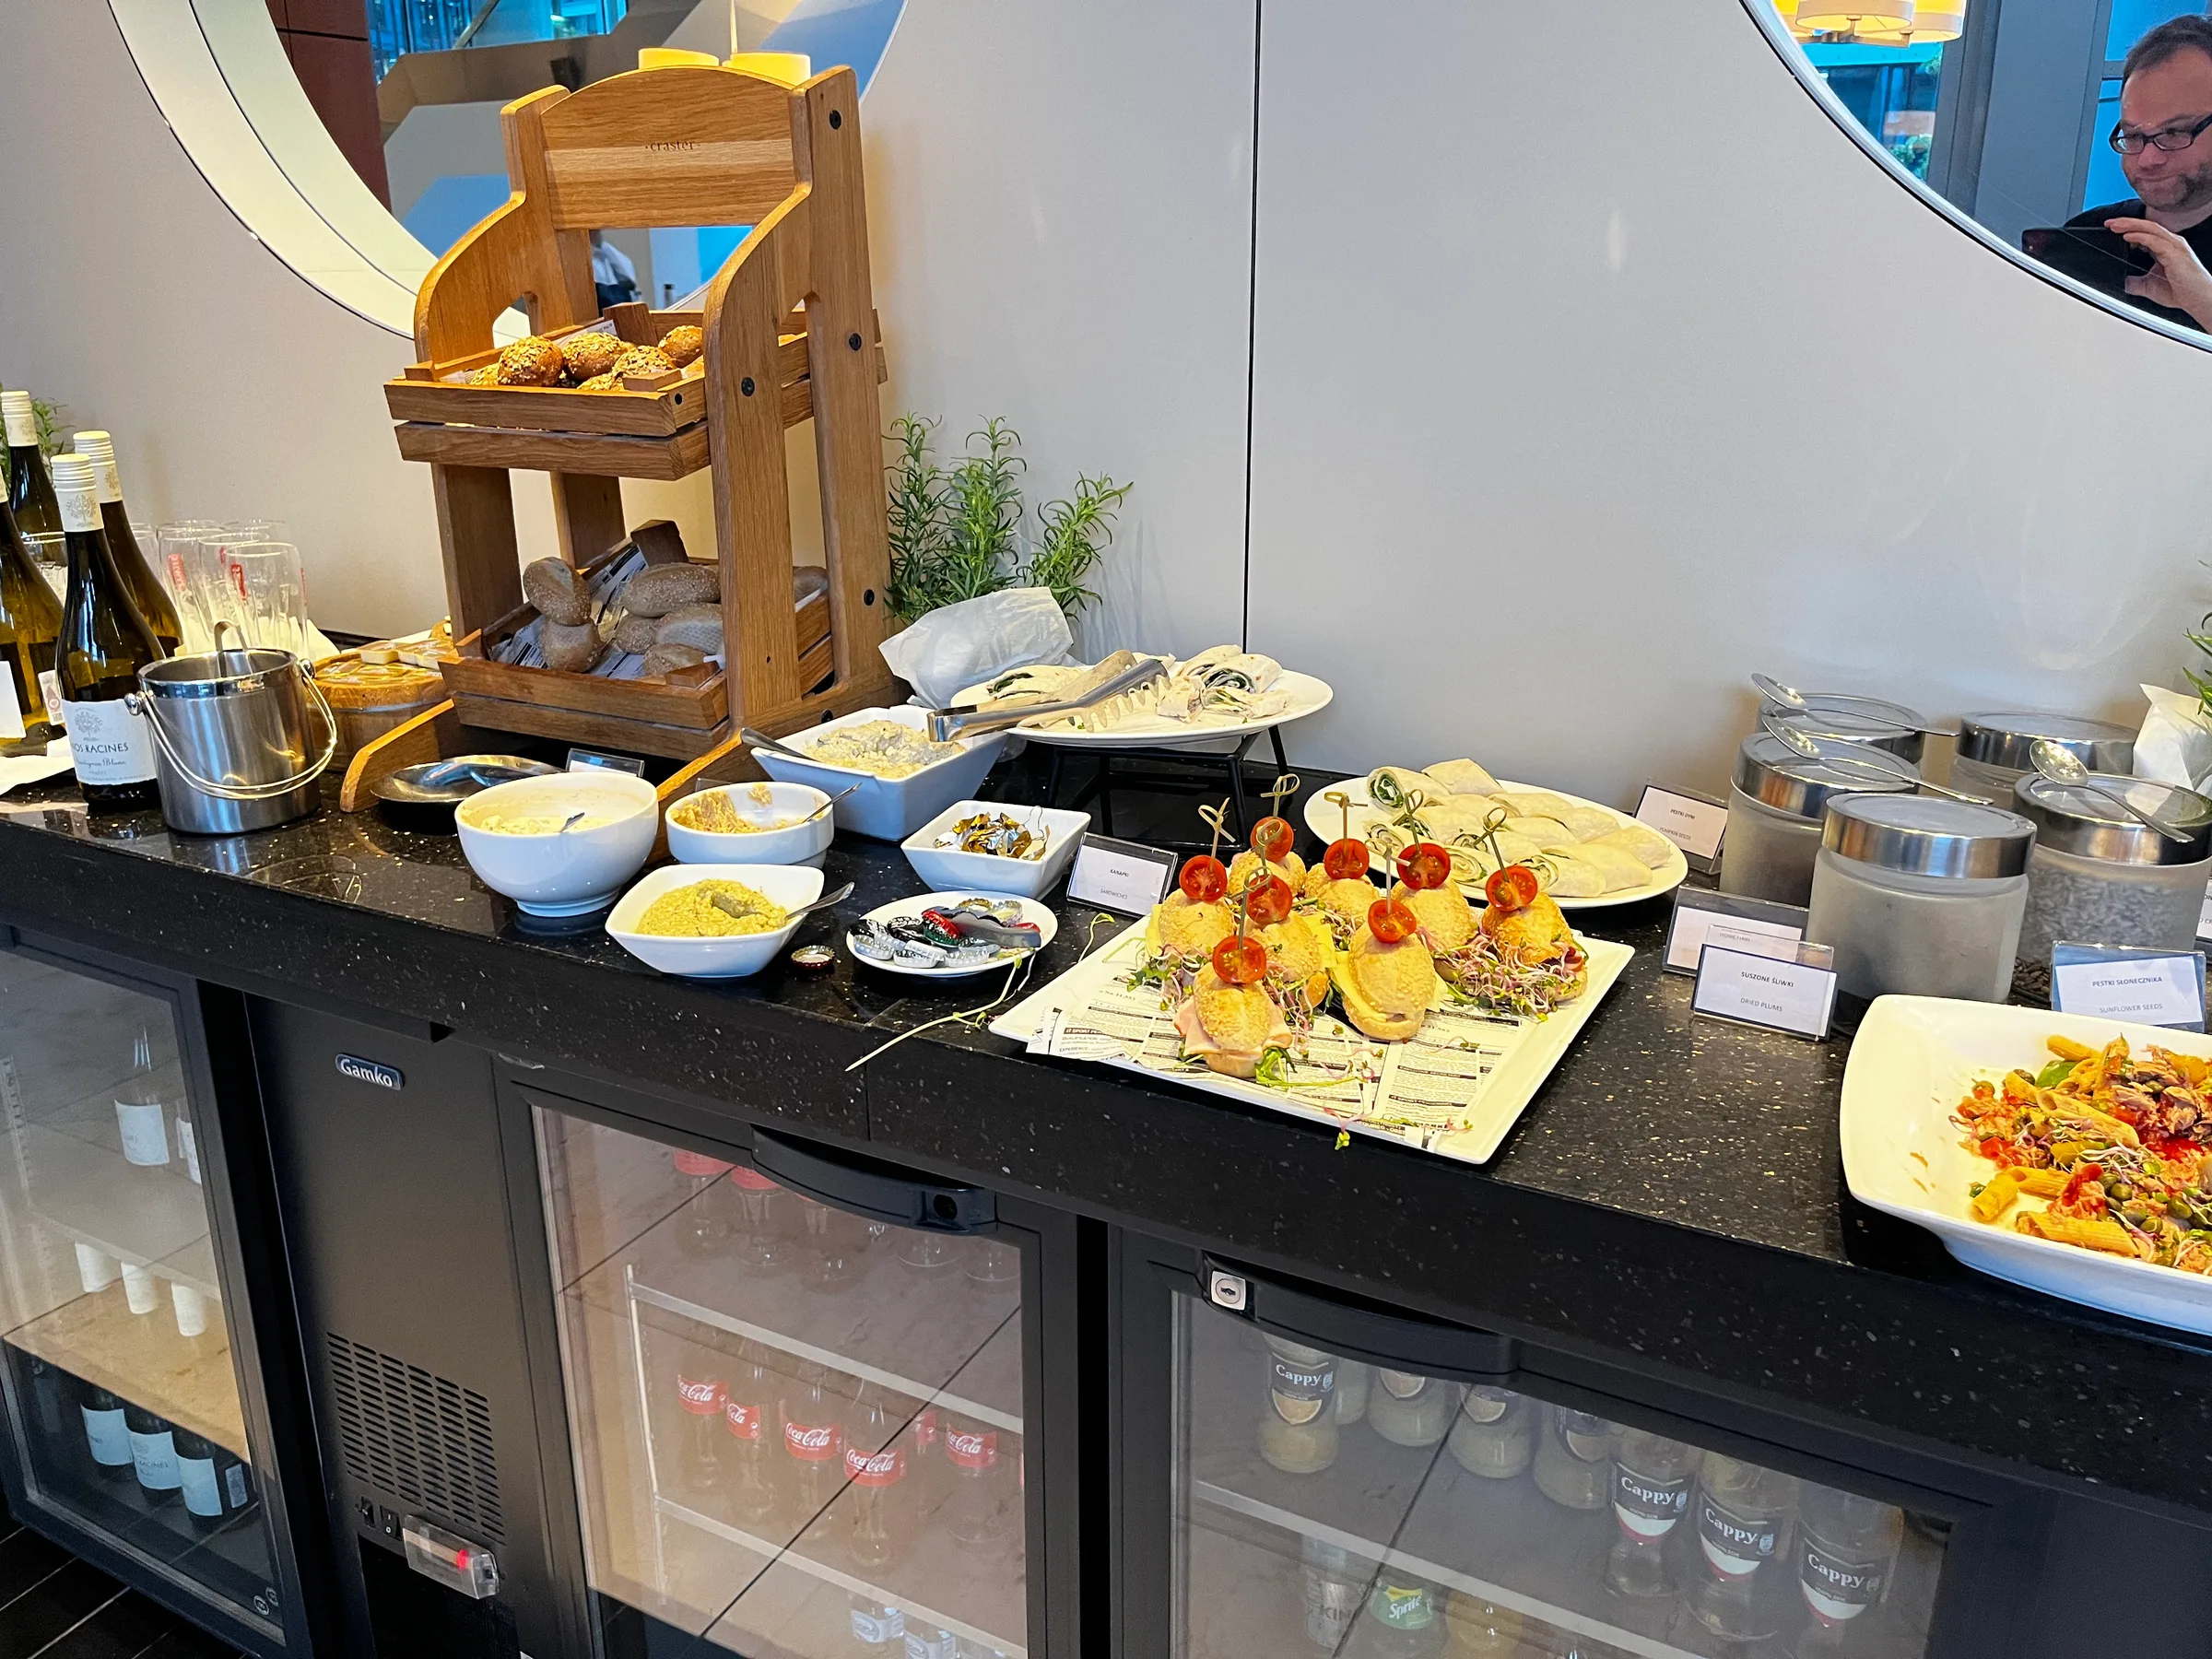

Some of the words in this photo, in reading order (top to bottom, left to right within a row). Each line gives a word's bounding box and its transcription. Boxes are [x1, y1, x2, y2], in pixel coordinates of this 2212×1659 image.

[650, 141, 696, 152] craster
[86, 742, 129, 754] RACINES
[1100, 888, 1128, 900] SANDWICHES
[1741, 971, 1771, 984] SUSZONE
[1771, 974, 1794, 988] ŚLIWKI
[2092, 978, 2115, 987] PESTKI
[2116, 976, 2163, 986] SŁONECZNIKA
[1740, 996, 1759, 1007] DRIED
[1760, 1001, 1783, 1012] PLUMS
[2100, 1004, 2142, 1014] SUNFLOWER
[2143, 1003, 2163, 1011] SEEDS
[340, 1058, 393, 1088] Gamko
[1276, 1364, 1322, 1386] Cappy
[785, 1422, 833, 1447] Coca-Cola
[847, 1448, 897, 1473] Coca-Cola
[1621, 1477, 1675, 1505] Cappy
[1705, 1507, 1759, 1545] Cappy
[1807, 1553, 1865, 1589] Cappy
[1388, 1595, 1422, 1620] Sprite
